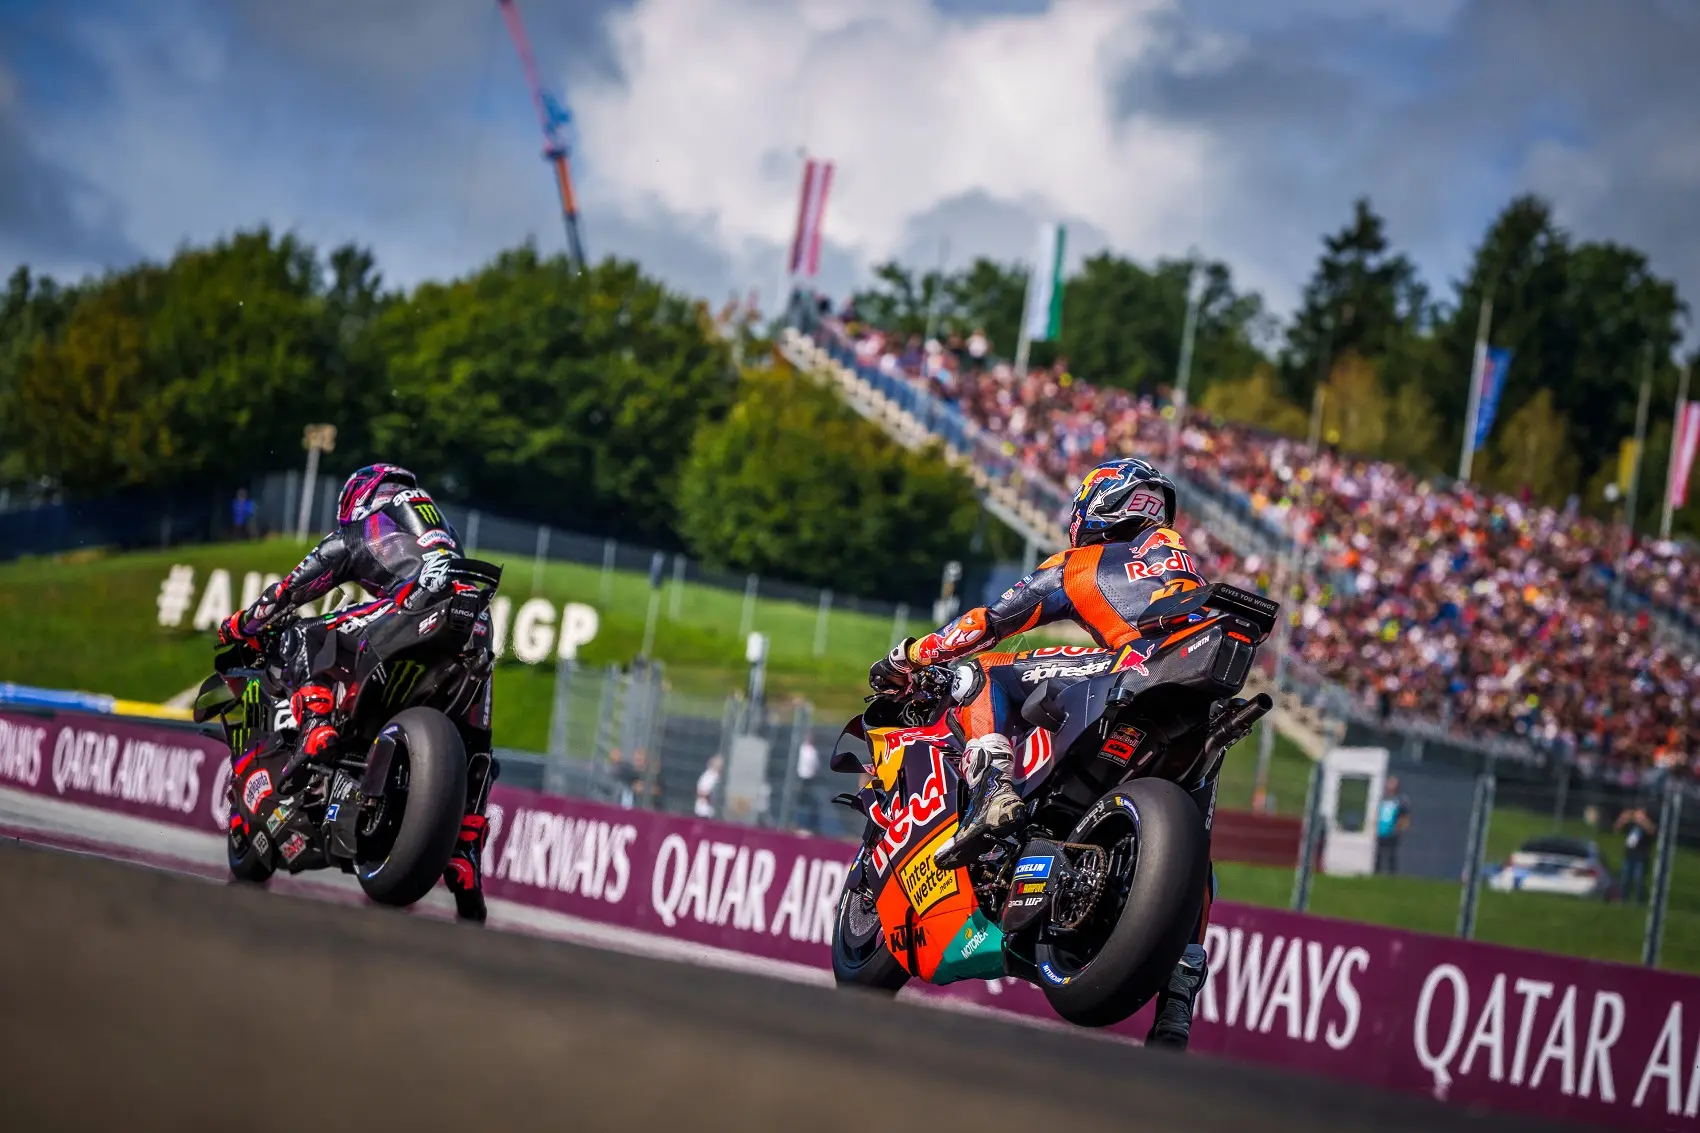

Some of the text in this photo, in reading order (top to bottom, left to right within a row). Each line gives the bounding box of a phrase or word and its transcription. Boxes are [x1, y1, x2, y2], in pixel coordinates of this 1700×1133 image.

[1127, 493, 1163, 516] 37
[1124, 550, 1186, 583] Red
[1220, 586, 1276, 611] GIVES YOU WINGS
[497, 807, 638, 904] AIRWAYS
[652, 833, 776, 927] QATAR
[960, 928, 989, 959] MOTOREX
[1413, 963, 1626, 1103] QATAR
